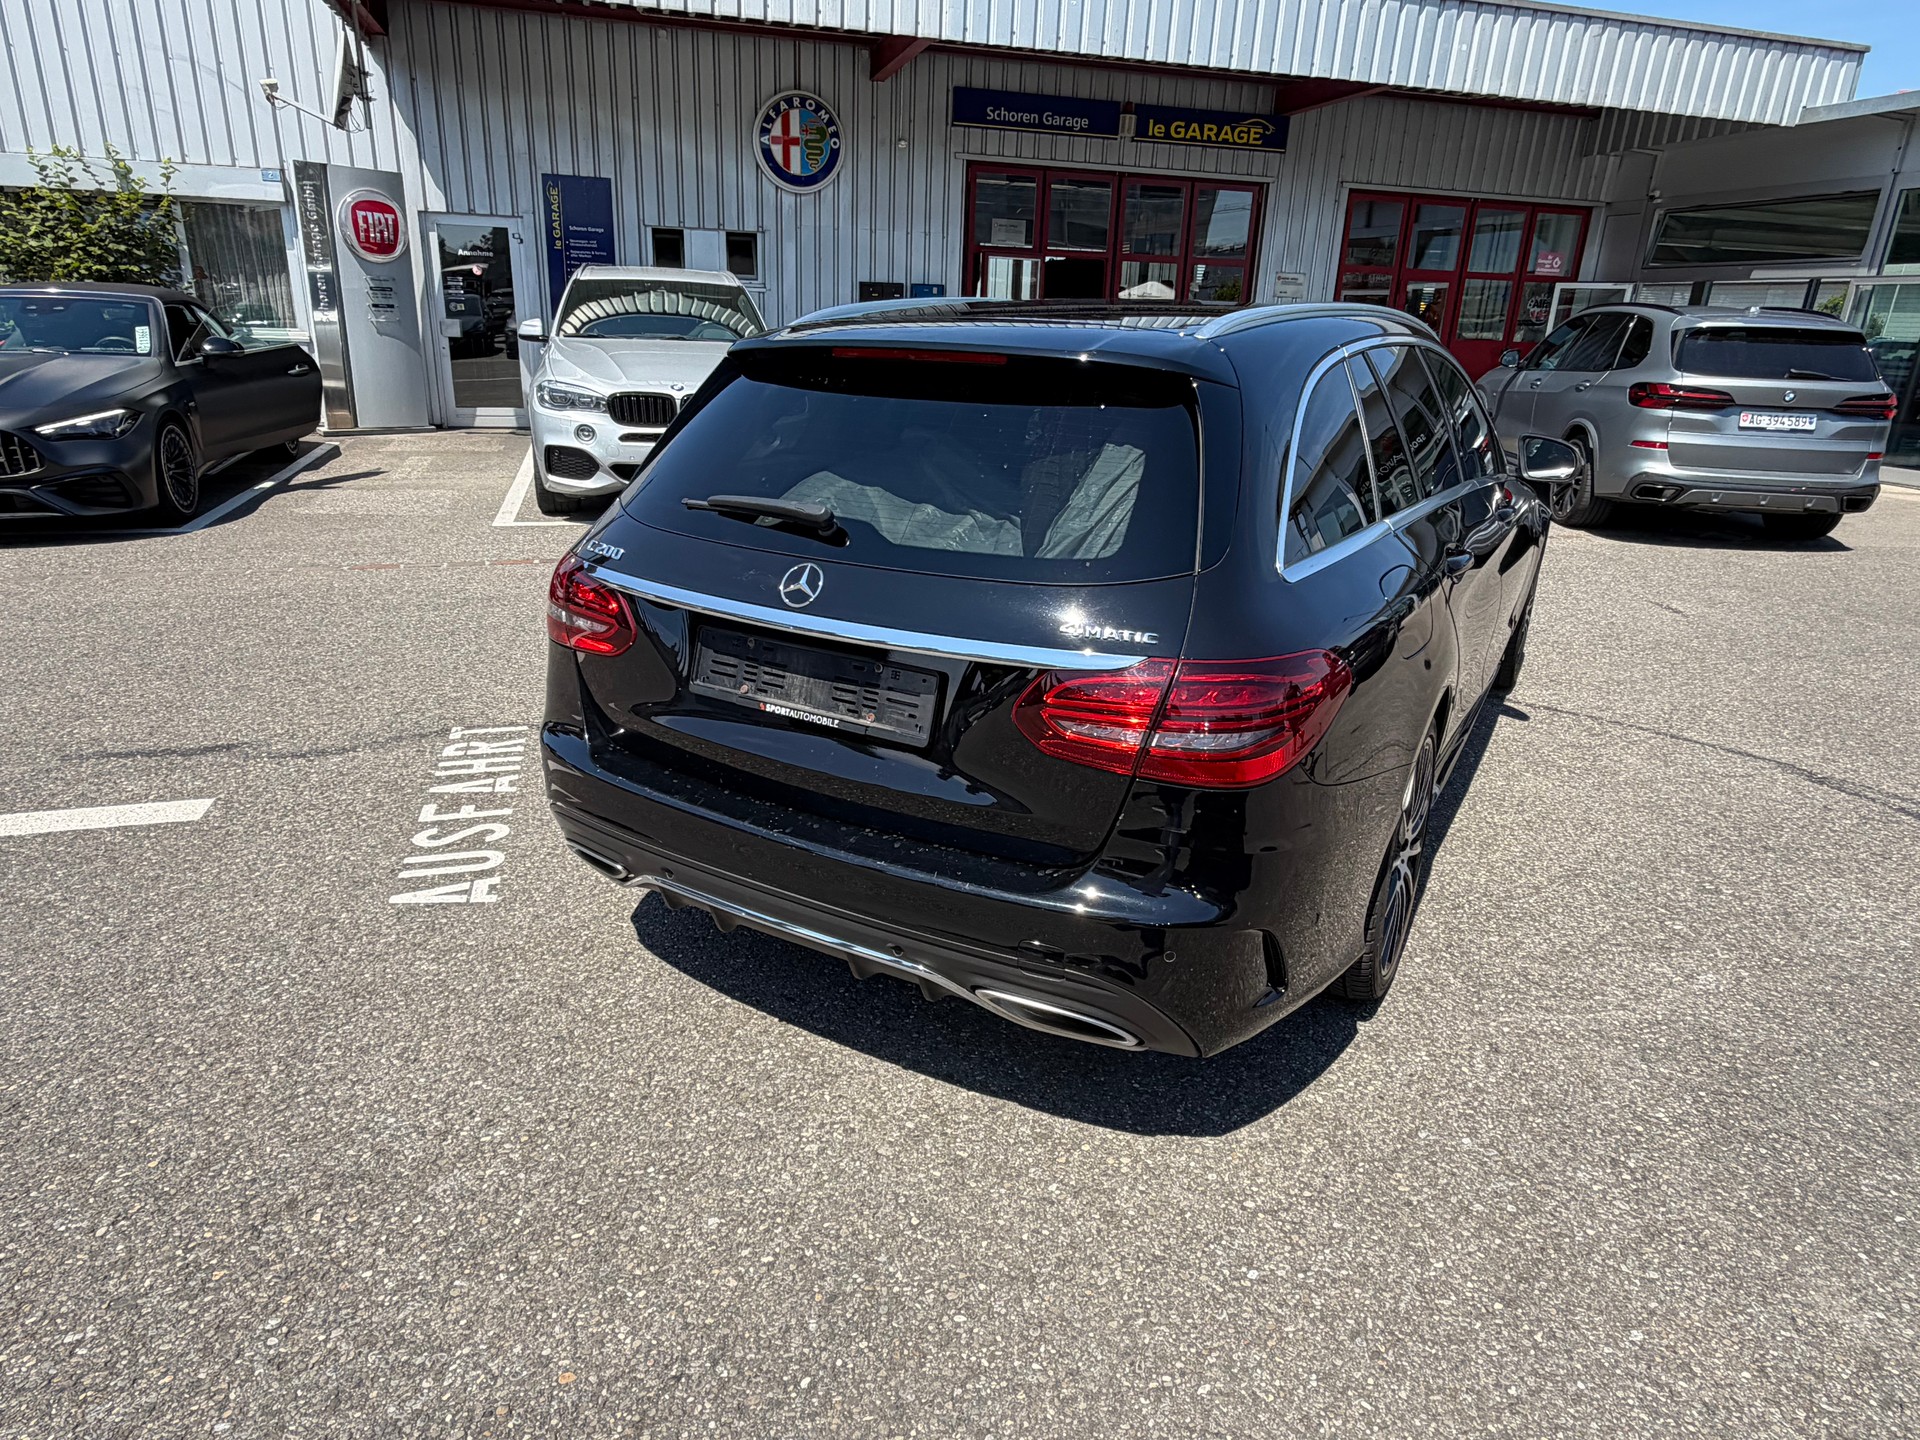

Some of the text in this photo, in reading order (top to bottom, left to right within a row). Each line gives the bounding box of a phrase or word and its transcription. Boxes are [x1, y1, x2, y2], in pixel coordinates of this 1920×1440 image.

[986, 106, 1089, 131] Schoren Garage
[1148, 119, 1263, 145] le GARAGE
[268, 170, 274, 179] 2
[355, 209, 396, 245] FIAT
[549, 187, 562, 249] le GARAGE
[594, 542, 625, 560] 200
[1059, 621, 1159, 645] 4MATIC
[765, 703, 839, 729] SPORTAUTOMOBILE
[388, 725, 529, 904] AUSFAHRT
